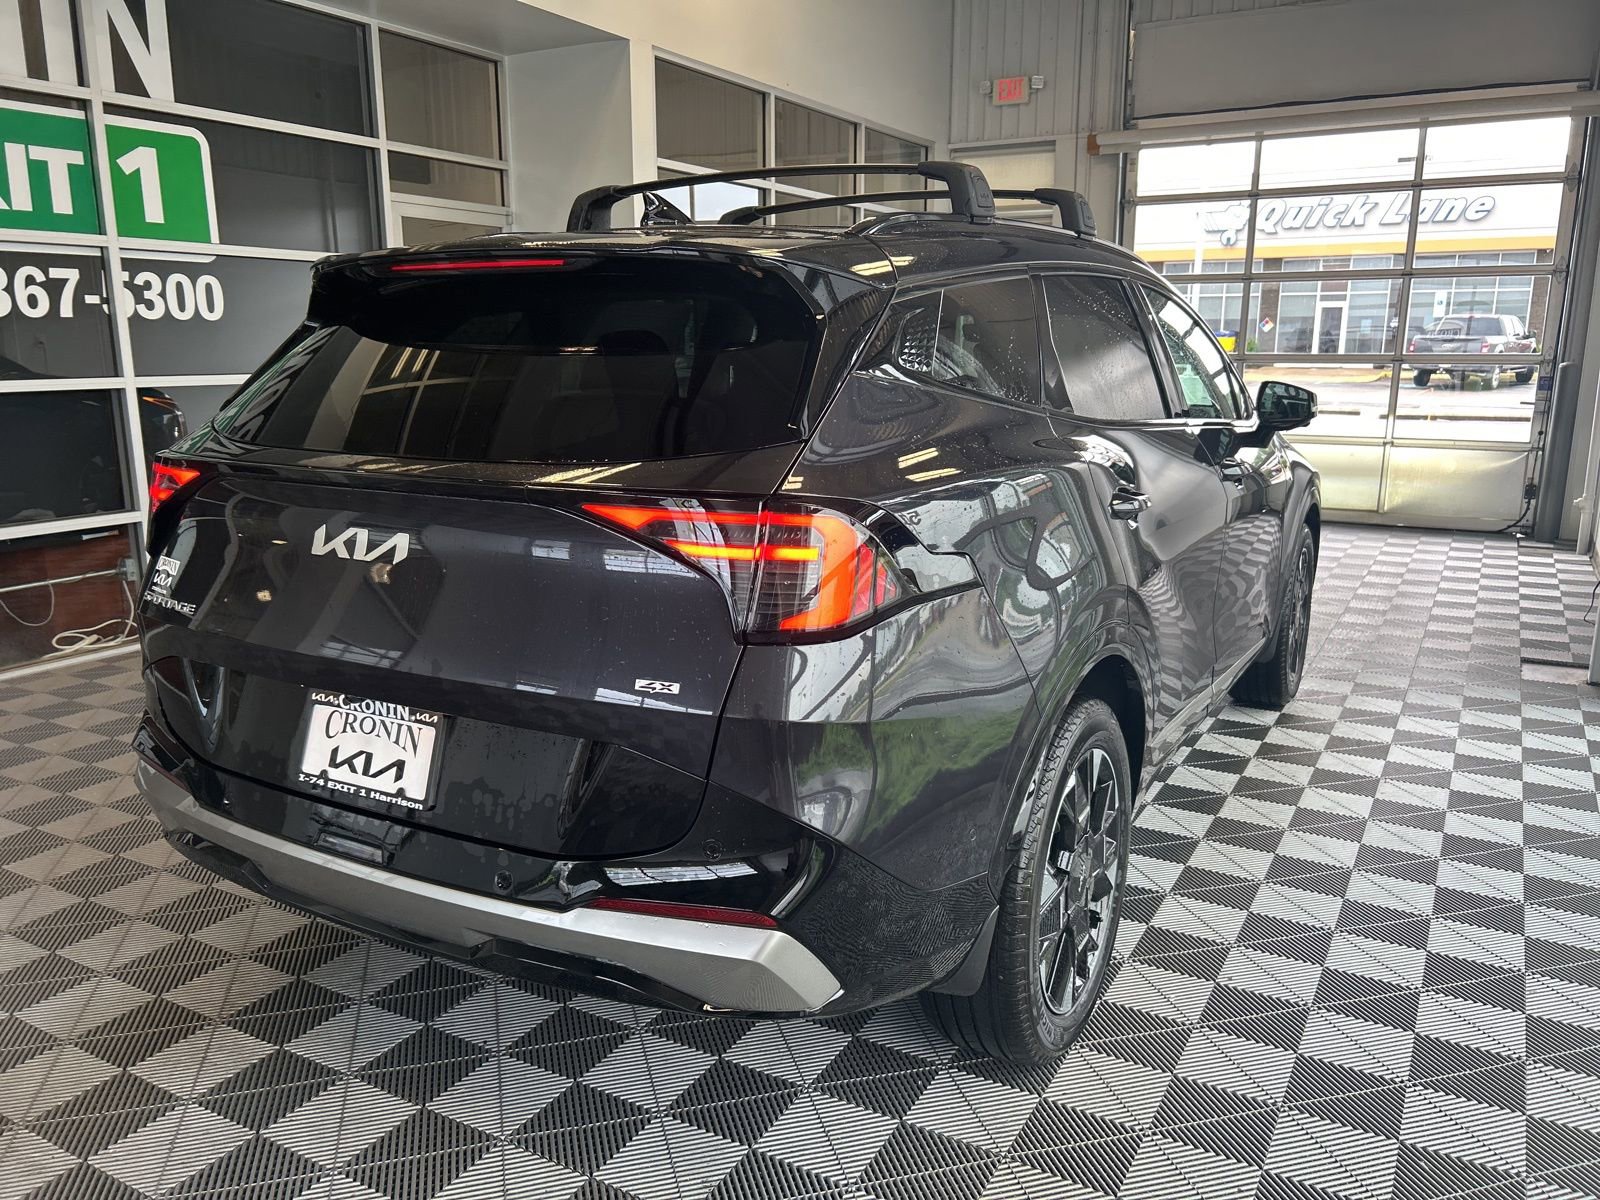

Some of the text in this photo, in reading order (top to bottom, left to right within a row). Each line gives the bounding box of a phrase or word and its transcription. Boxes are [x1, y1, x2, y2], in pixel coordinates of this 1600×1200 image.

[997, 78, 1025, 102] EXIT
[0, 142, 165, 224] IT 1
[1256, 192, 1496, 235] Quick Lane
[311, 523, 410, 565] KIA
[153, 571, 173, 588] KIA
[325, 709, 423, 759] CRONIN
[328, 745, 406, 784] KIA
[298, 773, 424, 811] I-74 EXIT 1 Harrison
